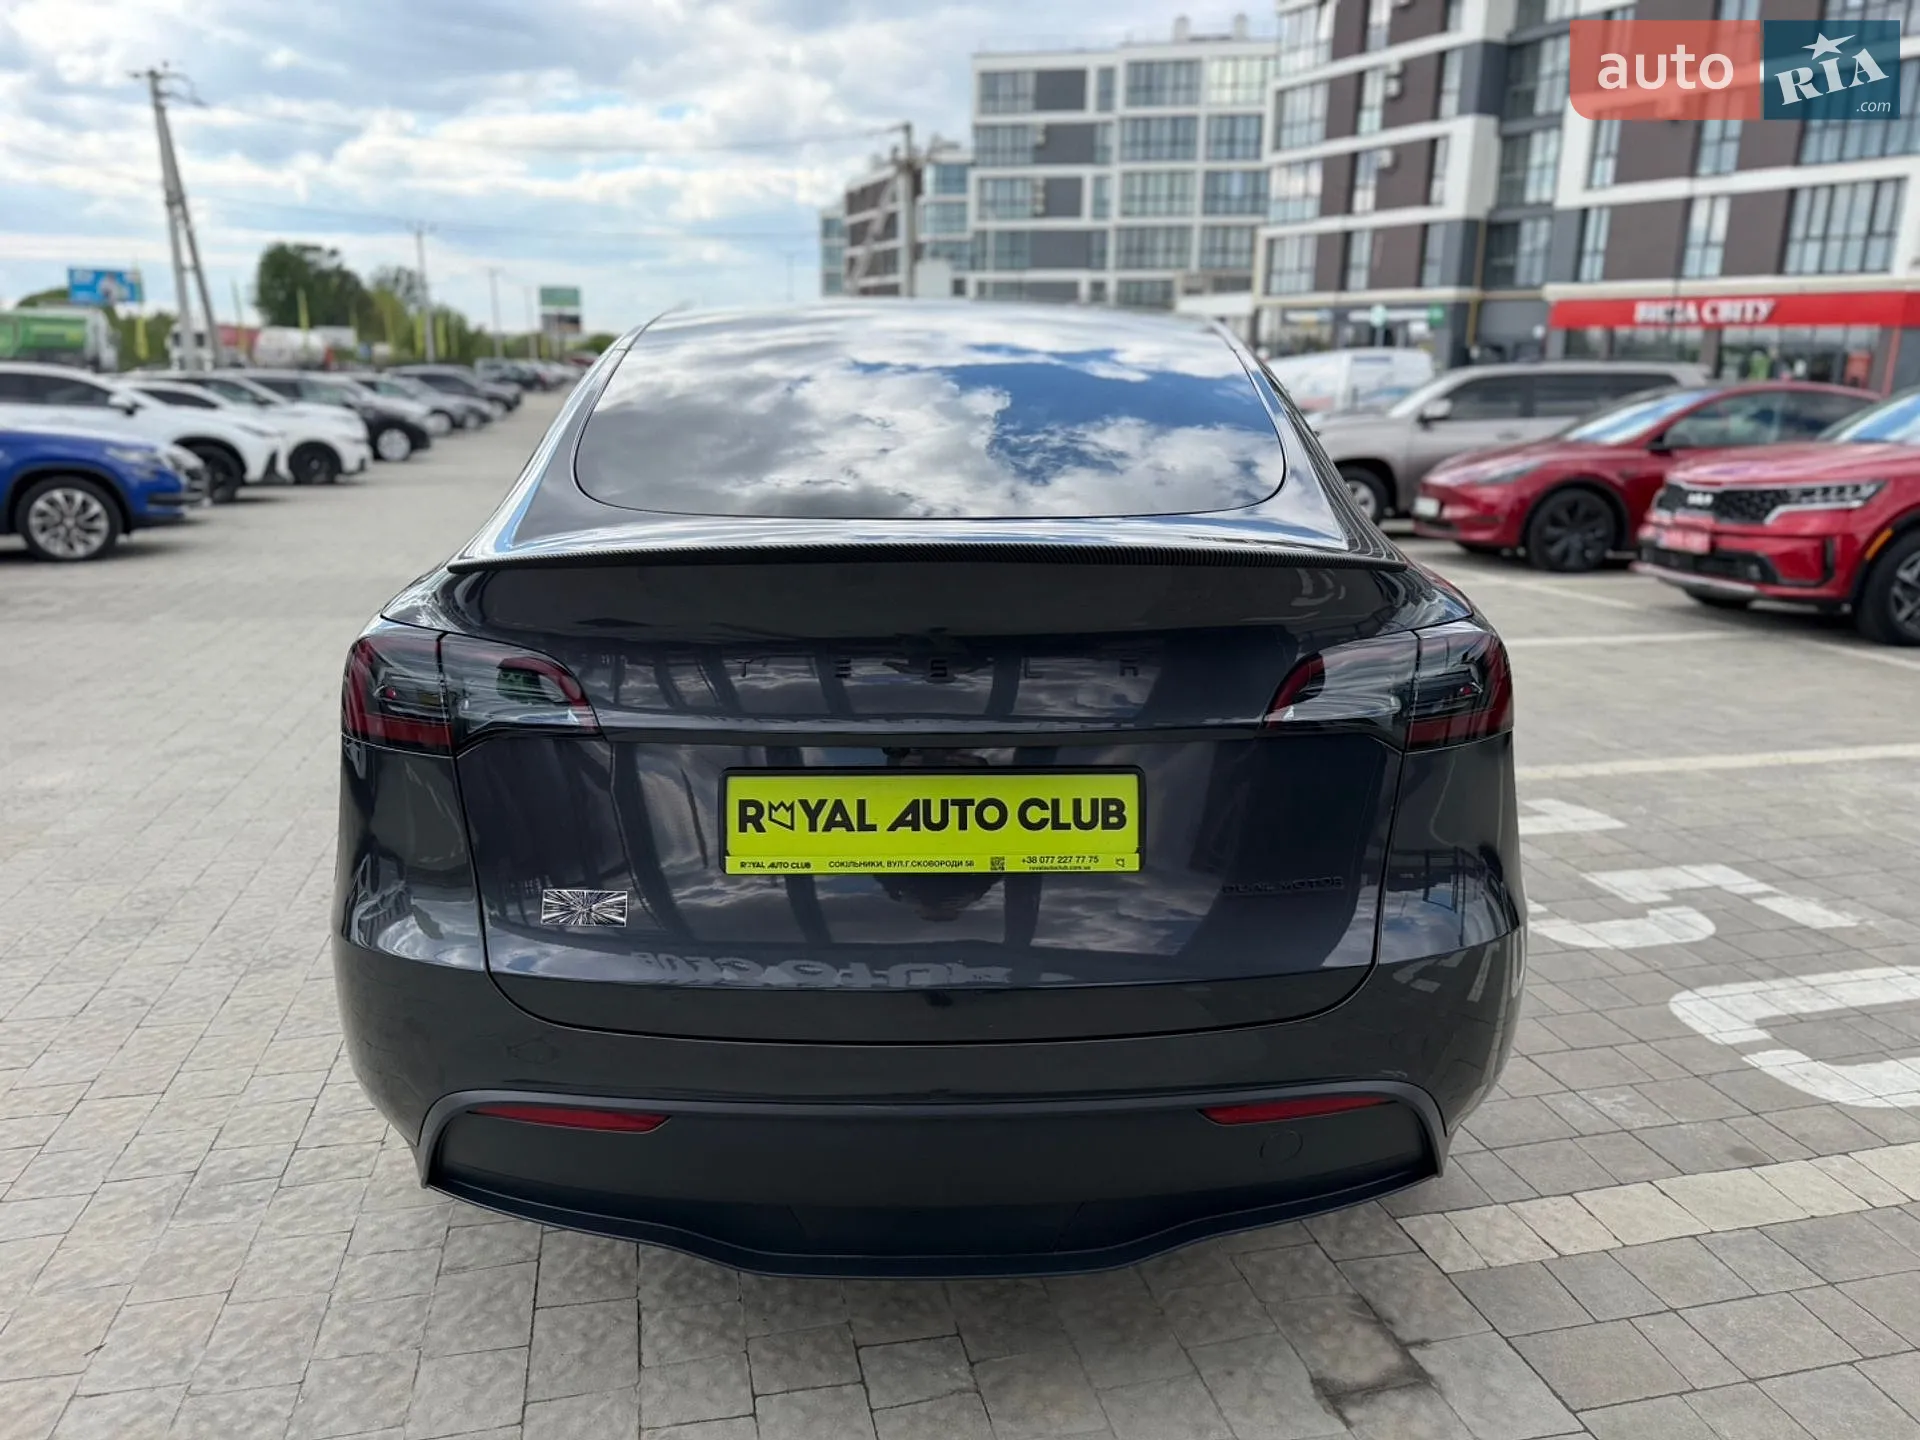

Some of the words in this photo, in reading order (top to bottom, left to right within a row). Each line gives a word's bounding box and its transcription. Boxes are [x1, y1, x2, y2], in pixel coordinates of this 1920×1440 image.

[734, 656, 1140, 679] TESLA
[887, 798, 1009, 832] AUTO
[1017, 797, 1127, 831] CLUB
[767, 861, 789, 869] AUTO
[790, 861, 812, 869] CLUB
[1022, 855, 1038, 864] +38
[1039, 855, 1055, 864] 077
[1057, 855, 1074, 864] 227
[1075, 855, 1087, 864] 77
